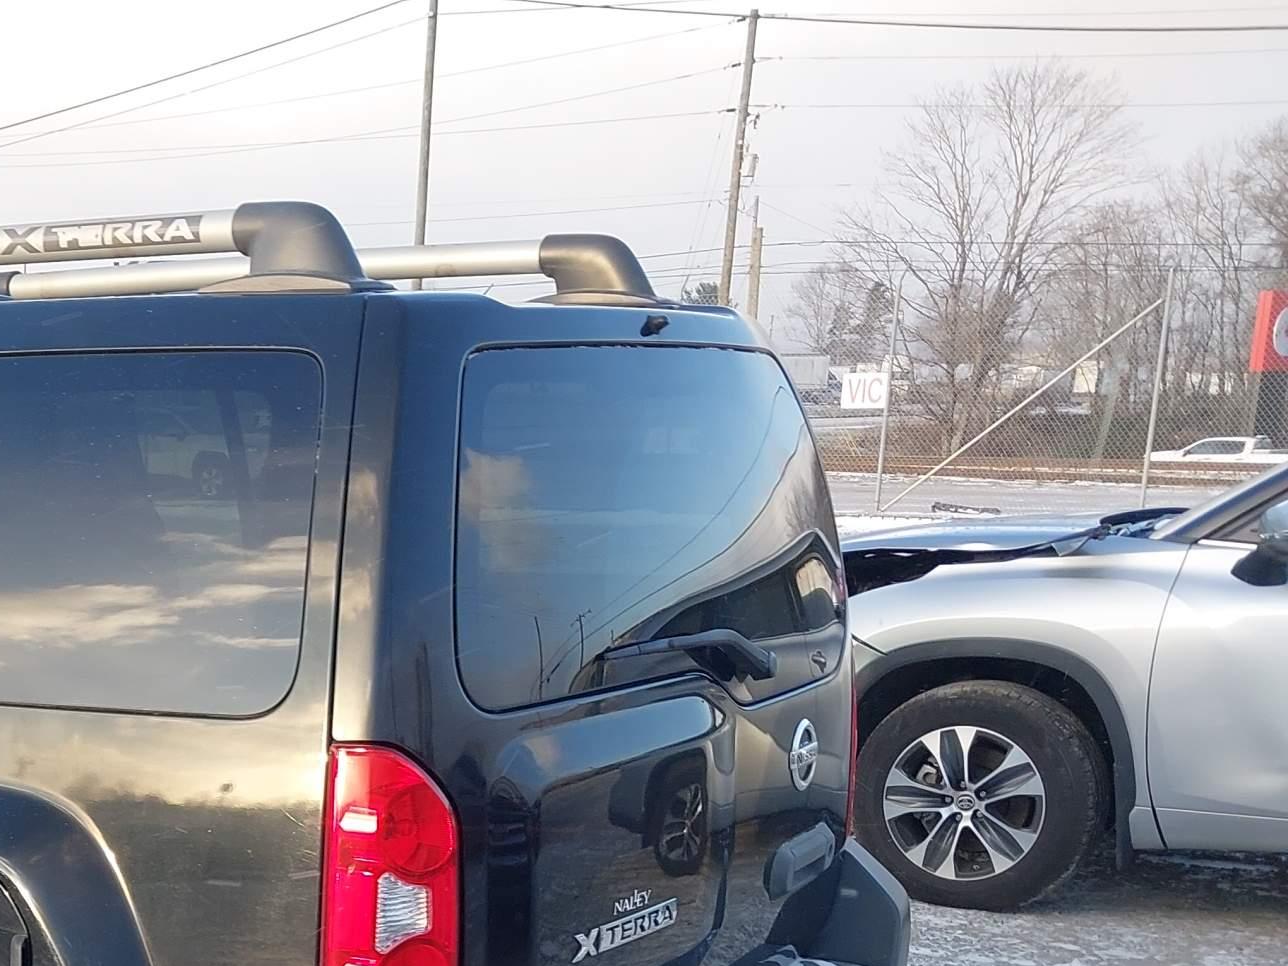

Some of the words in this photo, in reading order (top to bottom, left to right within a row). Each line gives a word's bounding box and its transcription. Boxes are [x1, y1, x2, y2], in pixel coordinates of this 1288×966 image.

[847, 377, 883, 404] VIC
[613, 889, 652, 916] NALLEY
[572, 897, 678, 963] XTERRA
